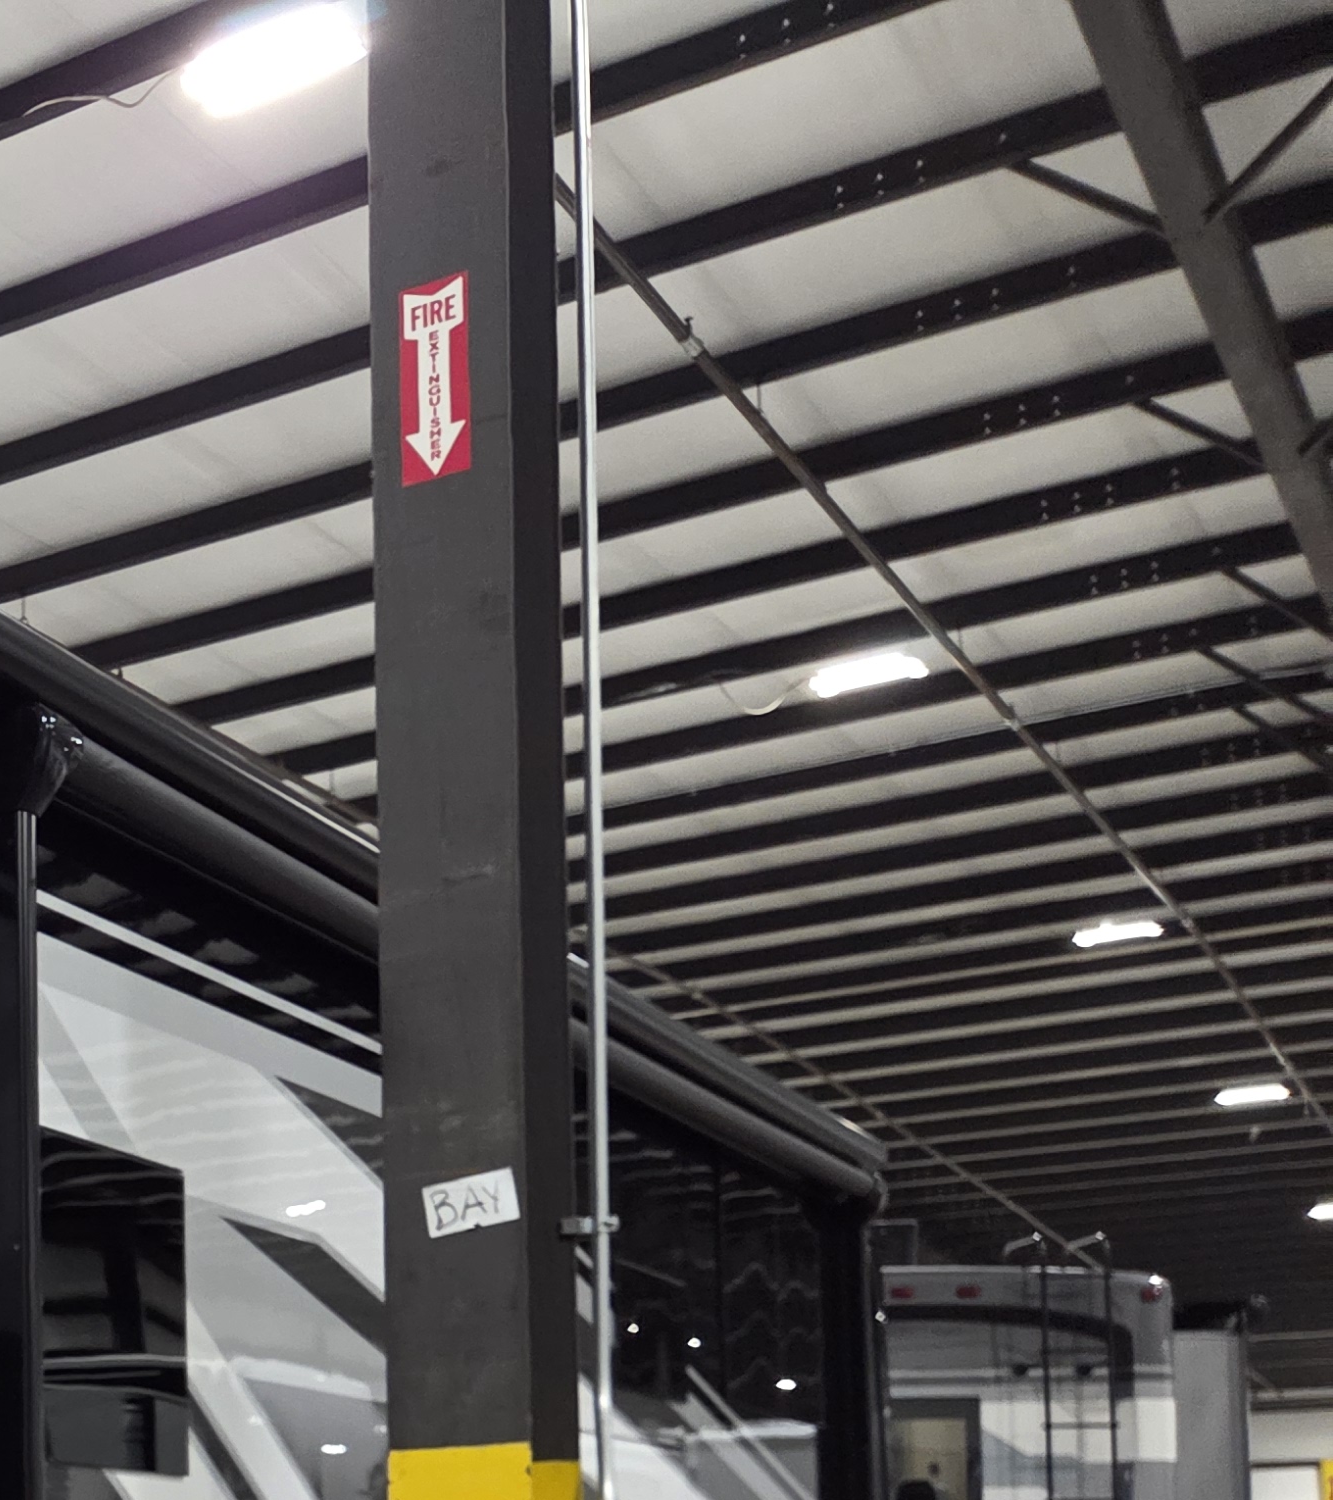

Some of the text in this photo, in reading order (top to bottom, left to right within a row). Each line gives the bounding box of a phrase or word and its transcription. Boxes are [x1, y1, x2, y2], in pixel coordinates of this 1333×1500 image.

[410, 293, 457, 332] FIRE
[428, 329, 442, 462] EXTINGUISHER
[429, 1180, 499, 1231] BAY
